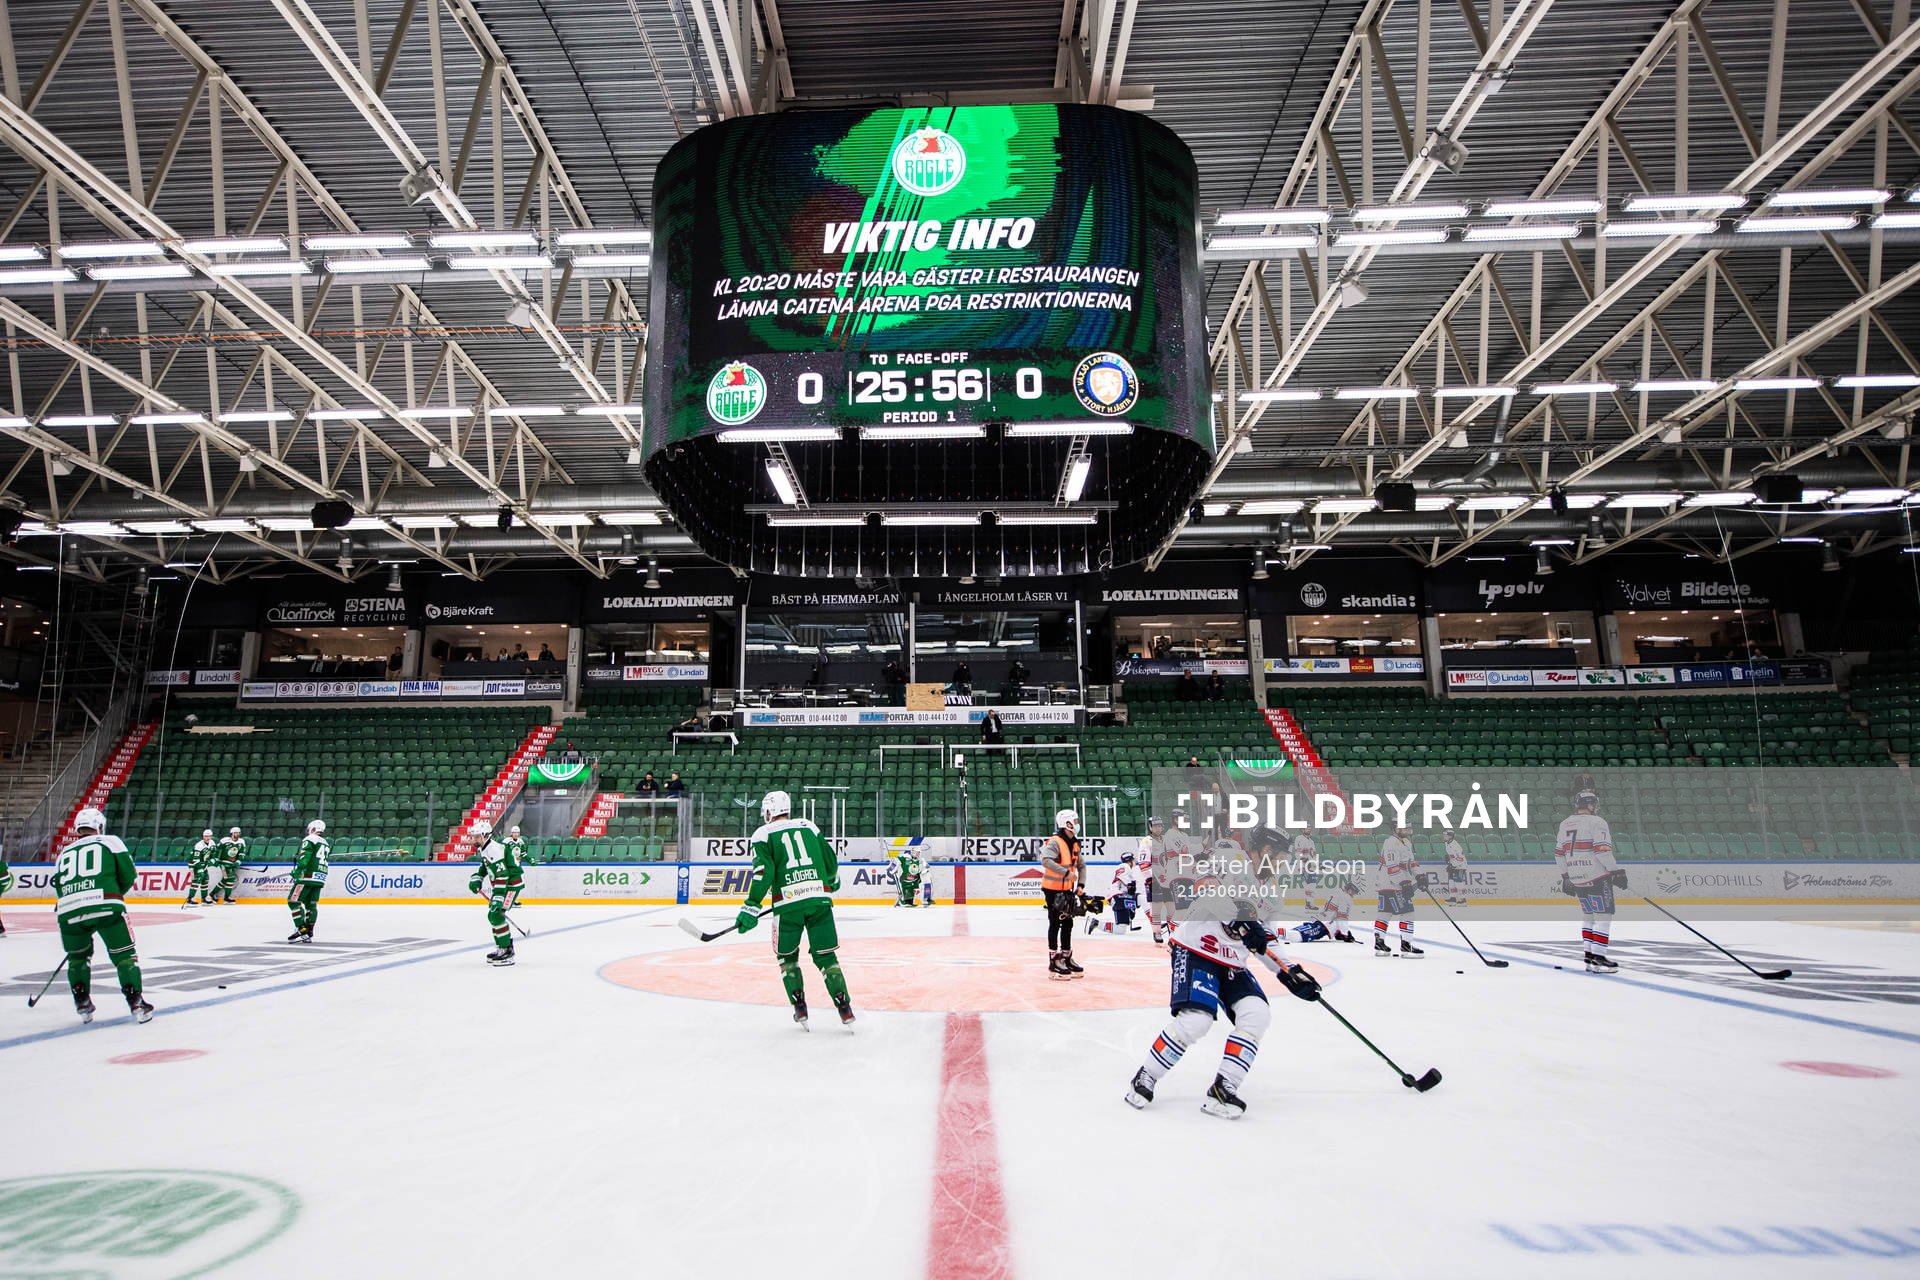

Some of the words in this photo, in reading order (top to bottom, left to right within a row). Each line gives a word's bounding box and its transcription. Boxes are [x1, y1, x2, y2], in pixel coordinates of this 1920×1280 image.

[904, 156, 954, 188] RÖGLE
[822, 220, 942, 254] VIKTIG
[947, 217, 1036, 250] INFO
[713, 278, 732, 296] KL
[736, 274, 790, 292] 20:20
[794, 268, 857, 288] MÅSTE
[861, 268, 907, 287] VÅRA
[912, 266, 983, 286] GÄSTER
[986, 268, 994, 284] I
[996, 266, 1140, 287] RESTAURANGEN
[718, 299, 778, 320] LÄMNA
[783, 298, 853, 315] CATENA
[858, 296, 920, 313] ARENA
[925, 294, 962, 310] PGA
[967, 292, 1132, 311] RESTRIKTIONERNA
[870, 354, 888, 365] TO
[896, 352, 968, 364] FACE-OFF
[798, 372, 824, 404] 0
[855, 369, 983, 403] 25:56
[1016, 368, 1042, 400] 0
[715, 388, 758, 418] RÖGLE
[884, 412, 938, 424] PERIOD
[948, 412, 956, 422] 1
[938, 594, 942, 602] I
[944, 592, 1014, 602] ÄNGELHOLM
[1018, 591, 1052, 601] LÄSER
[1056, 592, 1068, 600] VI
[1102, 589, 1238, 602] LOKALTIDNINGEN
[1626, 584, 1671, 601] Valvet
[1681, 582, 1750, 597] Bildeve
[360, 598, 406, 612] STENA
[603, 596, 734, 608] LOKALTIDNINGEN
[772, 594, 802, 604] BÄST
[804, 592, 818, 604] PÅ
[822, 594, 899, 604] HEMMAPLAN
[1342, 594, 1407, 608] skandia
[344, 613, 406, 622] RECYCLING
[443, 606, 466, 617] Bjäre
[468, 606, 494, 616] Kraft
[152, 674, 178, 682] indahl
[200, 674, 230, 682] Lindahl
[626, 668, 642, 678] LM
[680, 668, 704, 676] Lindab
[1450, 673, 1465, 684] LM
[1502, 674, 1528, 682] Lindab
[1694, 668, 1722, 678] melin
[402, 682, 420, 690] HNA
[422, 682, 439, 690] HNA
[781, 830, 813, 870] 11
[1566, 830, 1578, 857] 7
[59, 844, 102, 884] 90
[371, 874, 423, 890] Lindab
[582, 868, 629, 885] akea
[785, 868, 818, 885] SJÖGREN
[1684, 874, 1762, 887] FOODHILLS
[1802, 874, 1867, 888] Holmströms
[1870, 874, 1894, 888] Rör
[62, 879, 95, 896] BRITHÉN
